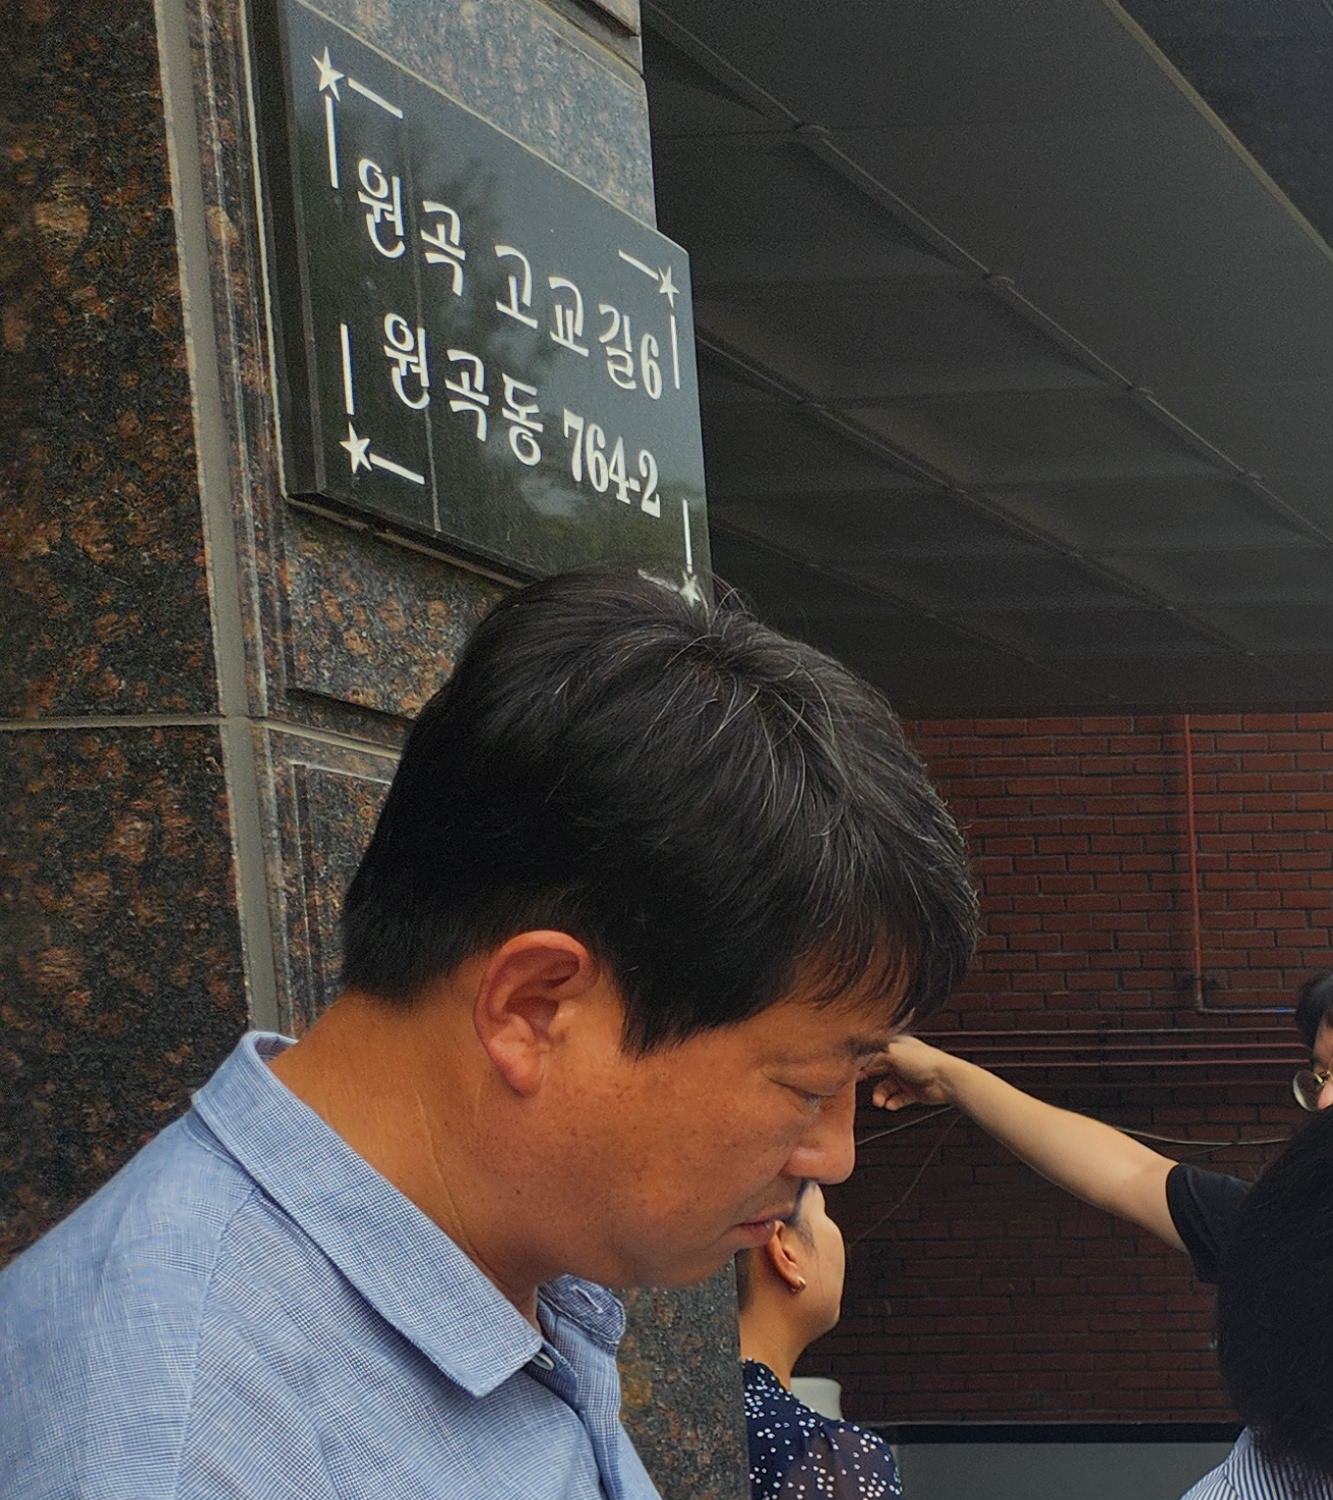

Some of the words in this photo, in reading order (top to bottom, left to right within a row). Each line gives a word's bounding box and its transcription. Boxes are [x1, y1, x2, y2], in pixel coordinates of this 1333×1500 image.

[358, 158, 466, 296] 원곡
[384, 312, 545, 467] 원곡동
[563, 409, 661, 518] 764-2
